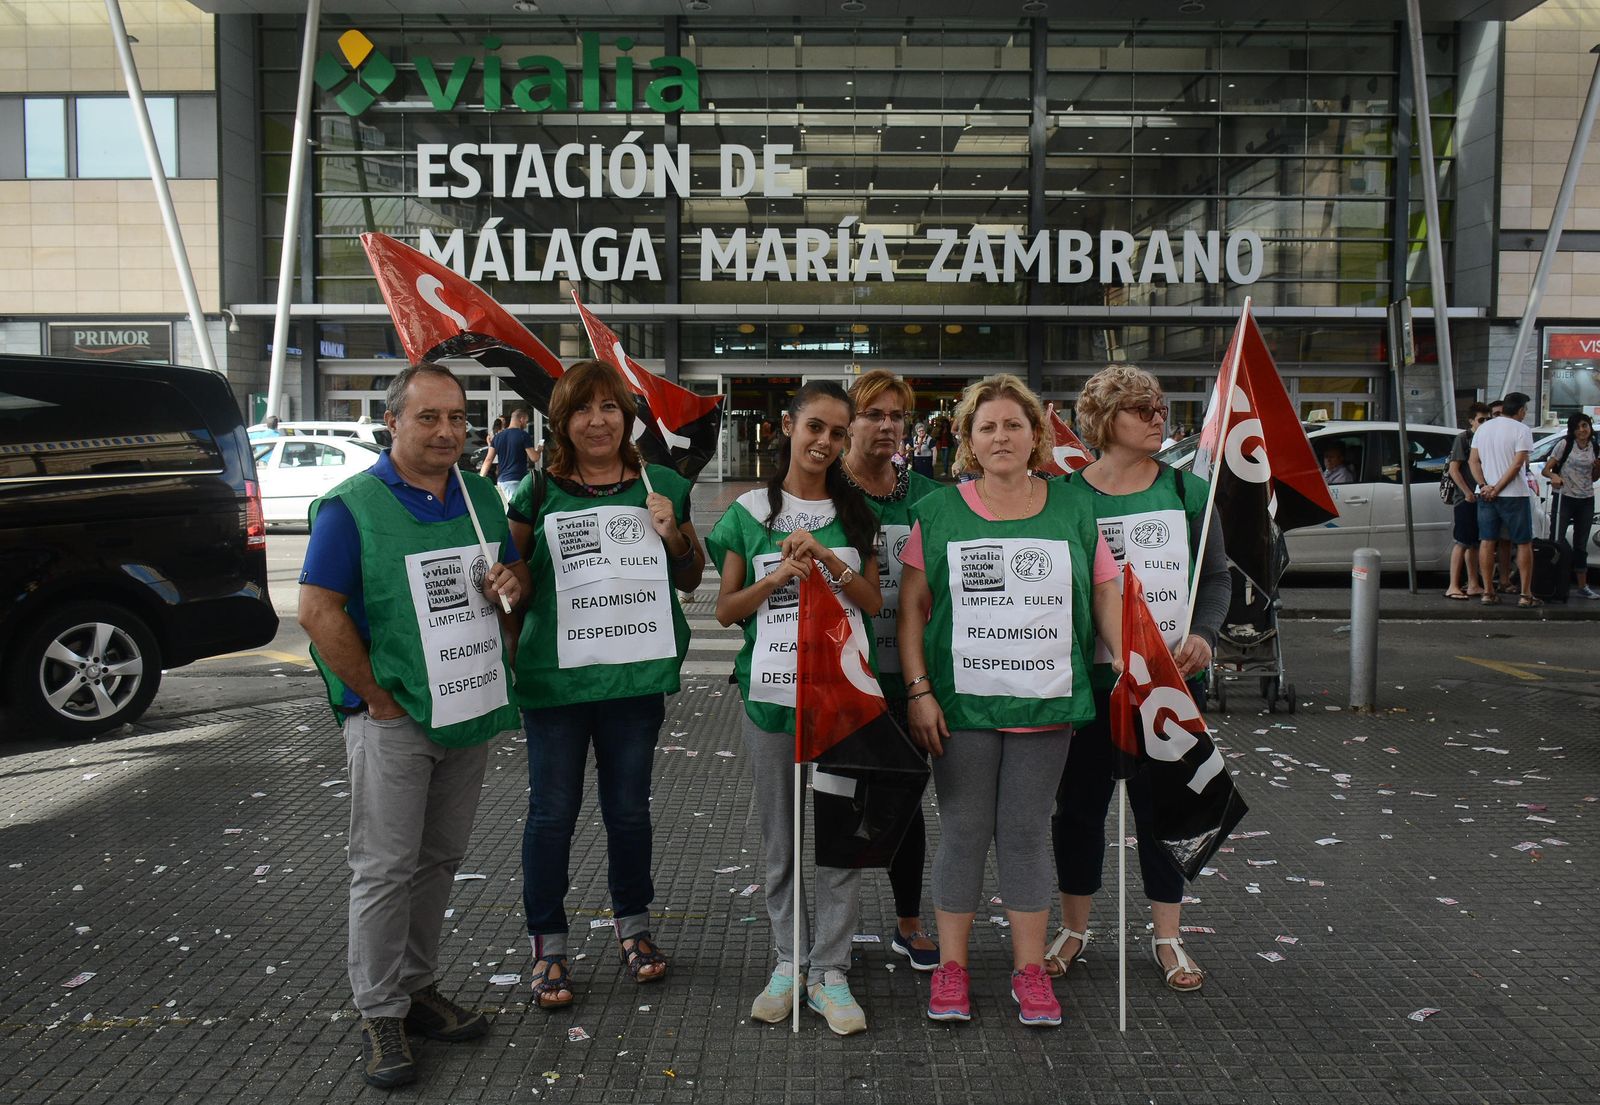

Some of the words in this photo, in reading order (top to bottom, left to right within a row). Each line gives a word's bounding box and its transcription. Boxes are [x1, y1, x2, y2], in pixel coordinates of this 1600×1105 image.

[412, 32, 700, 112] vialia
[416, 130, 691, 199] ESTACIÓN
[720, 143, 794, 197] DE
[419, 217, 663, 282] MÁLAGA
[700, 215, 896, 283] MARÍA
[926, 228, 1264, 284] ZAMBRANO
[74, 330, 151, 346] PRIMOR
[566, 519, 596, 529] vialia
[562, 557, 611, 574] LIMPIEZA
[620, 556, 658, 566] EULEN
[970, 551, 1001, 561] vialia
[1144, 560, 1180, 571] EULEN
[571, 589, 657, 610] READMISIÓN
[961, 596, 1014, 606] LIMPIEZA
[1024, 595, 1063, 606] EULEN
[428, 610, 476, 628] LIMPIEZA
[567, 621, 657, 641] DESPEDIDOS
[967, 625, 1058, 640] READMISIÓN
[440, 635, 498, 662] READMISIÓN
[963, 657, 1055, 671] DESPEDIDOS
[439, 669, 498, 697] DESPEDIDOS
